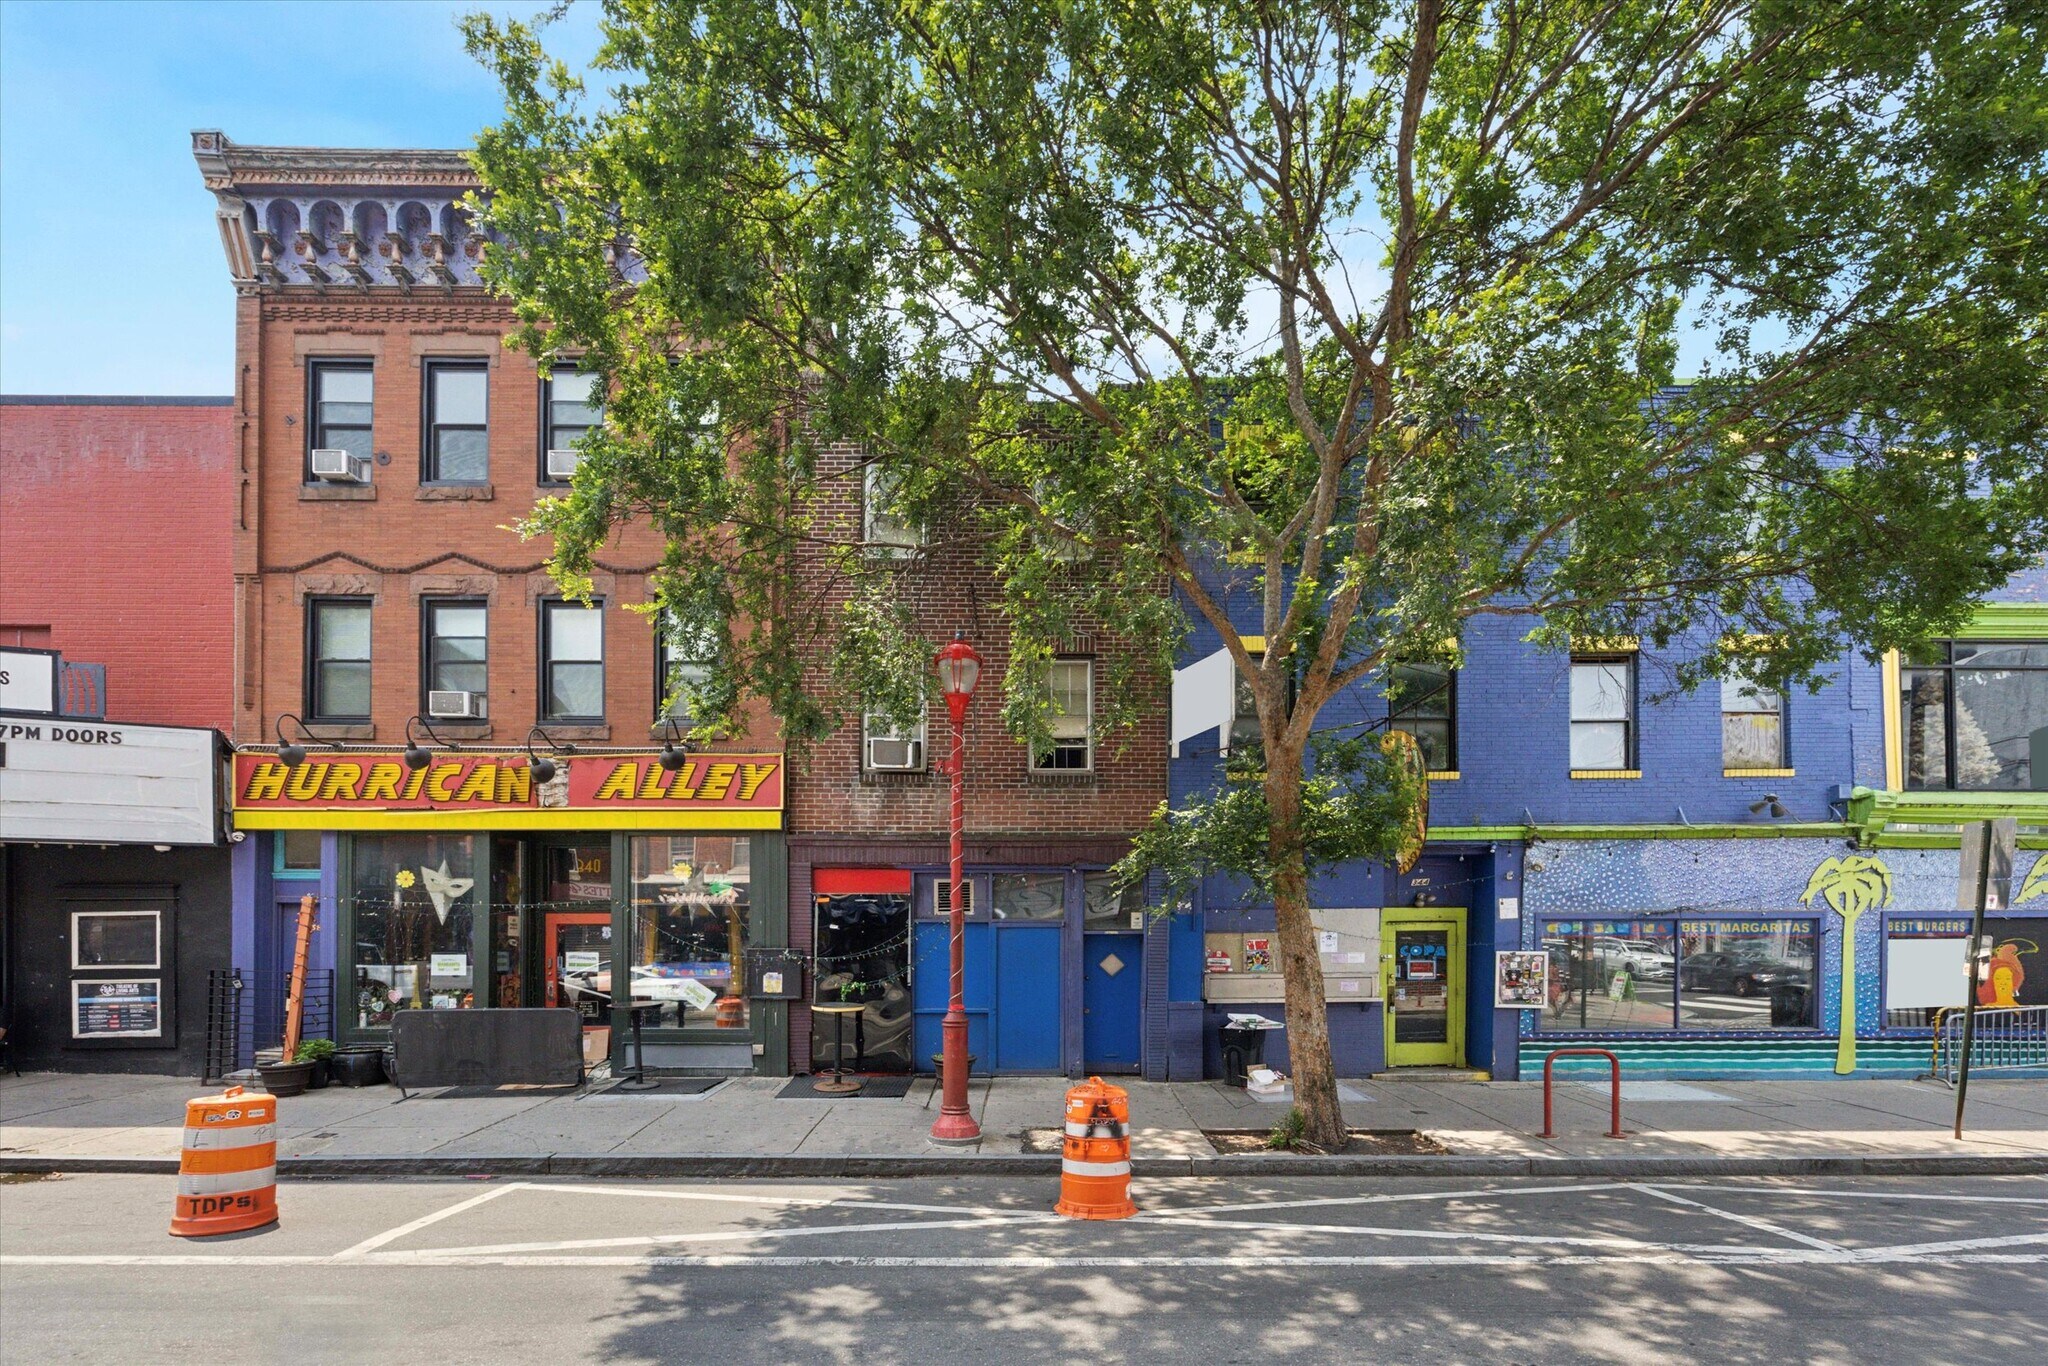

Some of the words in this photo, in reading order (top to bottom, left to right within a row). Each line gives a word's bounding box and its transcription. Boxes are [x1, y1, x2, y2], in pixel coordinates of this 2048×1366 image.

[52, 727, 122, 744] DOORS
[593, 762, 780, 801] ALLEY
[1681, 922, 1717, 933] BEST
[1720, 922, 1810, 933] MARGARITAS
[1888, 921, 1914, 932] BEST
[1917, 921, 1966, 932] BURGERS
[1400, 944, 1447, 957] COPA
[190, 1196, 251, 1215] TDPS
